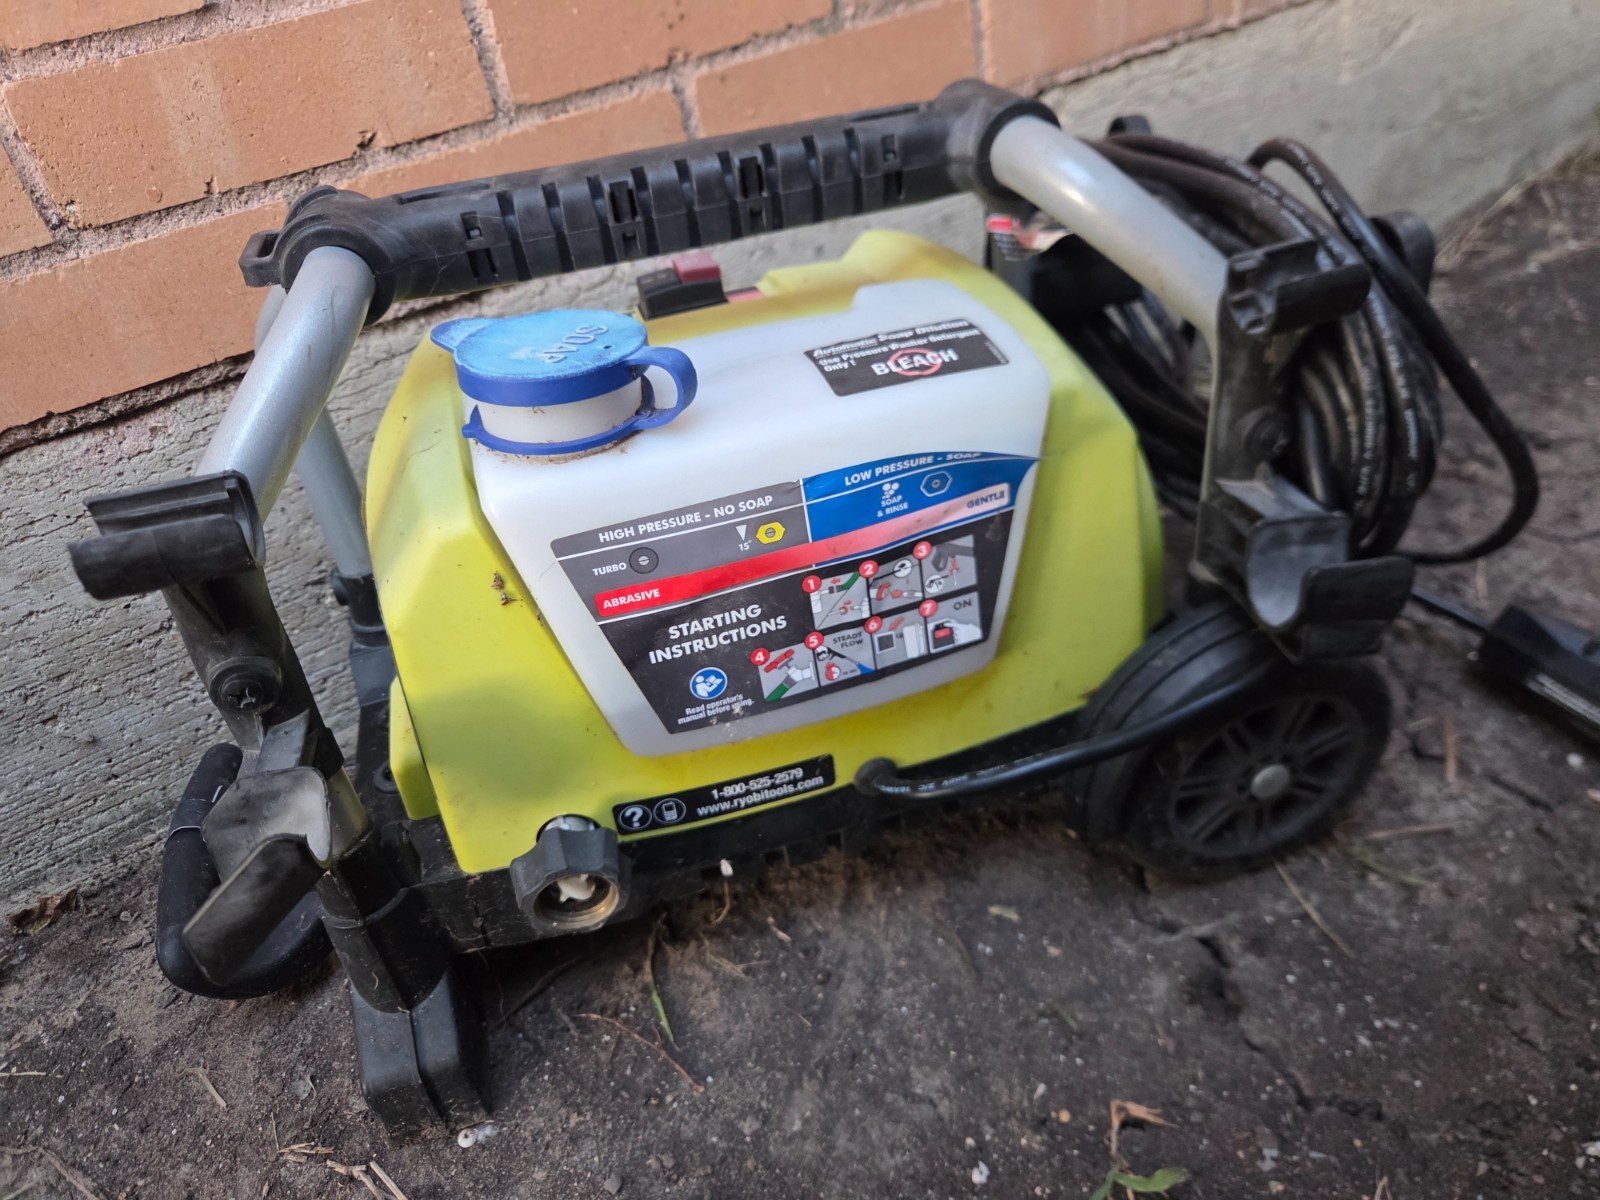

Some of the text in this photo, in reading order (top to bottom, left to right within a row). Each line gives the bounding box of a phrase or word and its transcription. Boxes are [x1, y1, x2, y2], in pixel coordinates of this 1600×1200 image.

[877, 330, 914, 343] Soap
[914, 320, 970, 335] Dilution
[539, 324, 608, 364] SOAP
[818, 356, 841, 366] Use
[841, 345, 889, 361] Pressure
[888, 337, 929, 351] Washer
[928, 328, 980, 342] Detergent
[823, 361, 849, 372] Only
[871, 348, 959, 375] BLEACH
[845, 469, 872, 486] LOW
[875, 455, 933, 477] PRESSURE
[945, 452, 982, 460] SOAP
[881, 495, 903, 508] SOAP
[966, 490, 1006, 509] GENTLE
[599, 526, 635, 543] HIGH
[638, 512, 701, 535] PRESSURE
[713, 504, 735, 518] NO
[738, 495, 773, 513] SOAP
[877, 502, 909, 518] & RINSE
[918, 544, 928, 556] 3
[592, 562, 627, 577] TURBO
[863, 563, 874, 575] 2
[602, 588, 661, 609] ABRASIVE
[952, 599, 972, 611] ON
[668, 604, 762, 640] STARTING
[868, 619, 878, 630] 6
[648, 615, 788, 664] INSTRUCTIONS
[808, 636, 819, 647] 5
[832, 631, 863, 644] STEADY
[840, 638, 863, 649] FLOW
[754, 651, 765, 663] 4
[677, 711, 706, 725] manual
[706, 704, 731, 717] before
[685, 693, 744, 716] Read operator's
[711, 767, 804, 800] 1-800-525-2579
[696, 774, 824, 817] www.ryobitools.com
